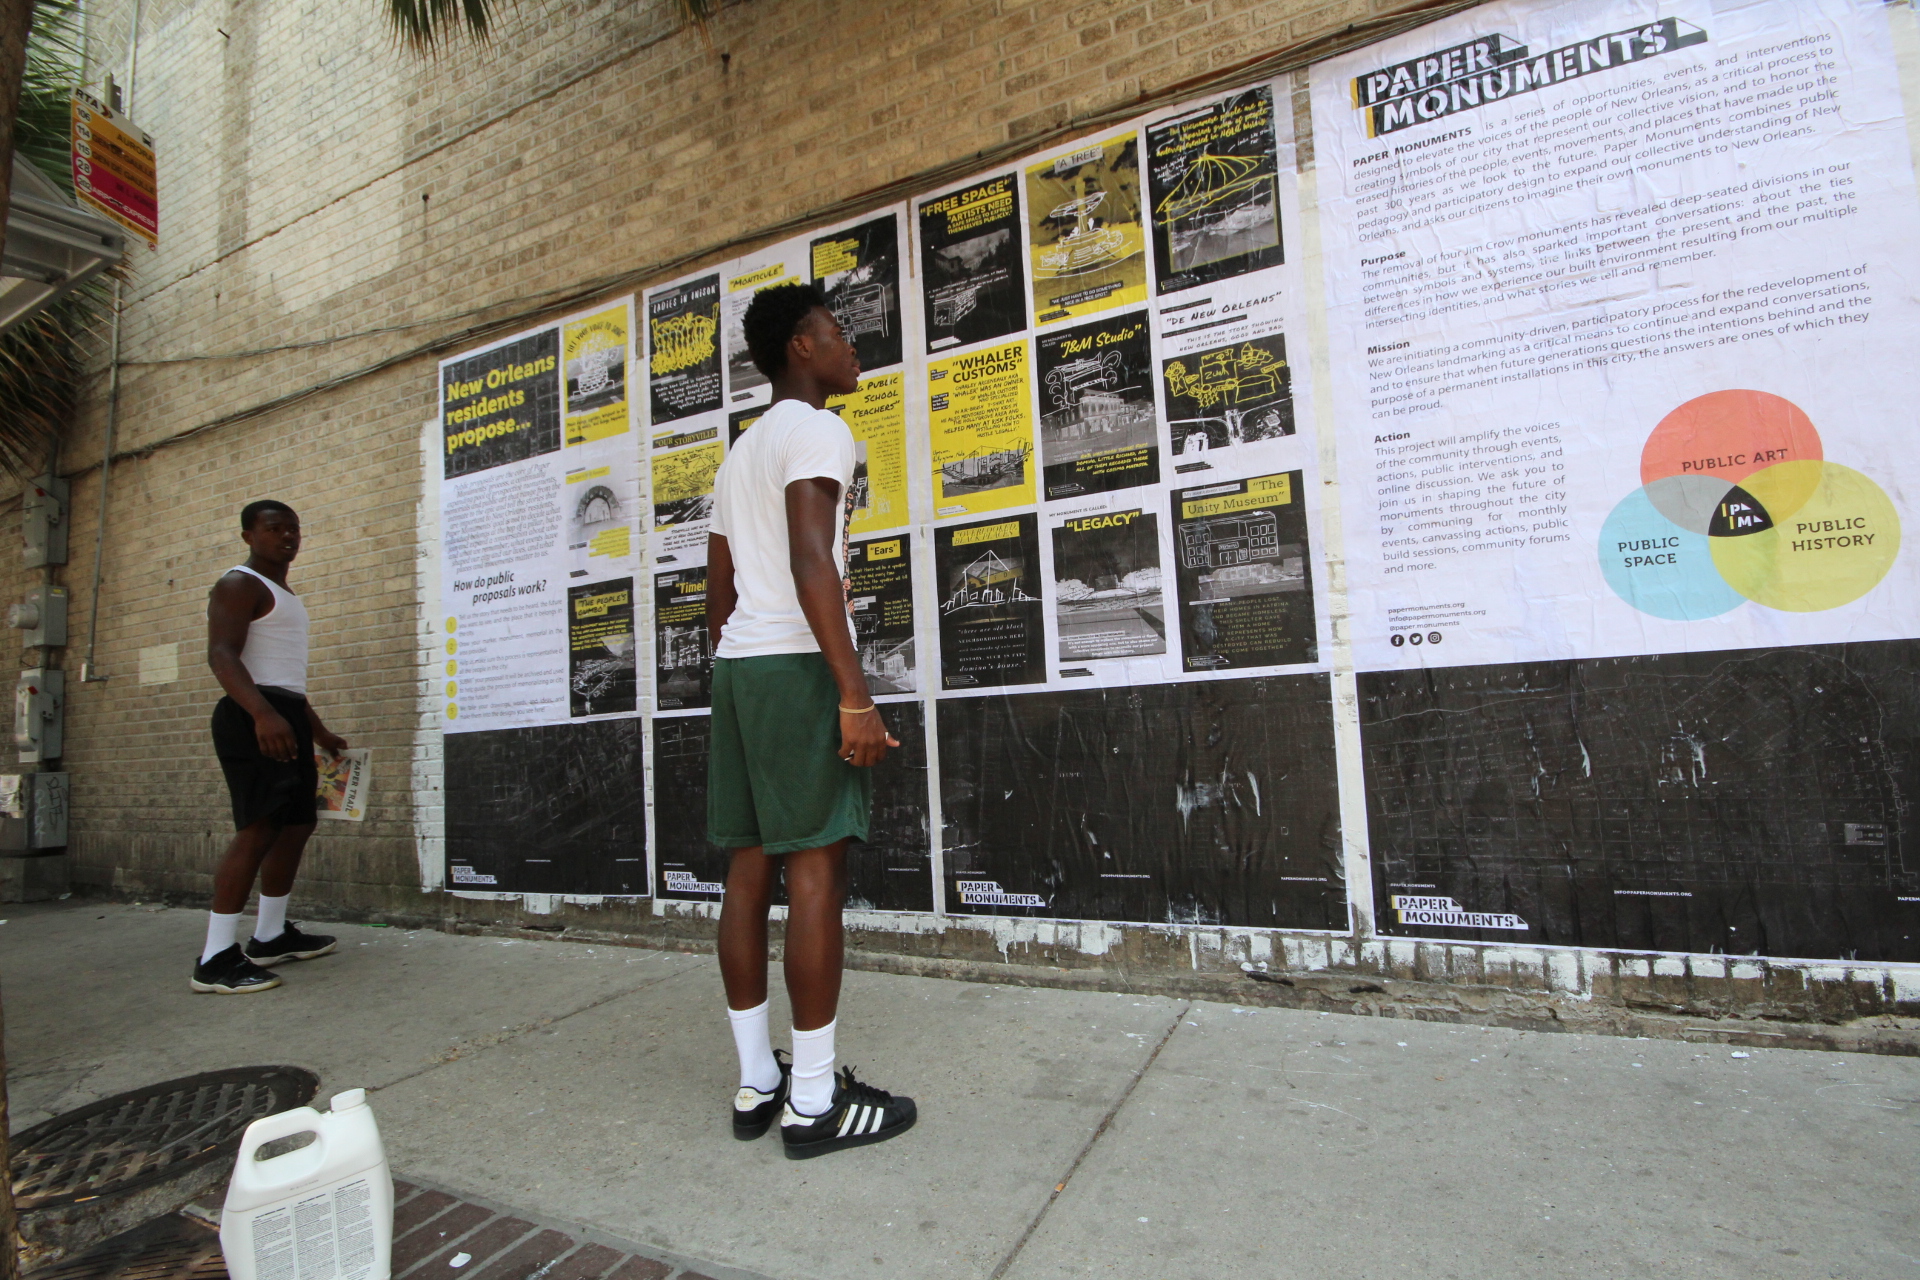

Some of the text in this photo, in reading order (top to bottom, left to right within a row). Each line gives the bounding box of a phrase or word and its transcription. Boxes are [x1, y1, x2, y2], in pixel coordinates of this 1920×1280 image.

[1367, 42, 1493, 103] PAPER
[1383, 24, 1667, 131] MONUMENTS
[76, 88, 98, 109] RTA
[77, 107, 90, 121] 106
[1057, 147, 1100, 168] "A TREE"
[1353, 127, 1472, 167] PAPER MONUMENTS
[78, 159, 90, 174] 28
[920, 178, 1011, 217] "FREE SPACE"
[948, 198, 1012, 223] "ARTISTS NEED
[948, 221, 982, 234] THEMSELVES
[1361, 251, 1406, 266] Purpose
[730, 265, 783, 288] "MONTICULE"
[1167, 291, 1281, 325] "DE NEW ORLEANS"
[1061, 324, 1141, 358] "J&M Studio"
[1367, 341, 1410, 355] Mission
[953, 346, 1022, 370] "WHALER
[447, 355, 556, 402] New Orleans
[953, 358, 1022, 383] CUSTOMS"
[867, 377, 898, 390] PUBLIC
[864, 390, 898, 403] SCHOOL
[447, 390, 525, 425] residents
[852, 400, 900, 418] TEACHERS"
[447, 418, 531, 454] propose...
[655, 437, 673, 446] "OUR
[1374, 431, 1410, 443] Action
[1375, 421, 1560, 456] This project will amplify the voices
[1376, 435, 1562, 469] of the community through events,
[1682, 448, 1788, 472] PUBLIC ART
[1377, 447, 1563, 483] actions, public interventions, and
[1253, 480, 1283, 490] "The
[1378, 462, 1564, 496] online discussion. We ask you to
[1378, 474, 1566, 510] join us in shaping the future of
[1188, 491, 1284, 515] Unity Museum"
[1380, 490, 1566, 522] monuments throughout the city
[1730, 504, 1740, 515] P
[1066, 511, 1140, 532] "LEGACY"
[1381, 504, 1567, 536] by communing for monthly
[1738, 516, 1752, 527] M
[1797, 517, 1866, 534] PUBLIC
[1382, 518, 1568, 548] events, canvassing actions, public
[1792, 534, 1875, 552] HISTORY
[870, 544, 897, 555] "Ears"
[1383, 533, 1570, 561] build sessions, community forums
[1618, 537, 1680, 552] PUBLIC
[1384, 562, 1437, 574] and more.
[1624, 553, 1677, 568] SPACE
[453, 570, 515, 592] How do public
[472, 579, 547, 606] proposals work?
[1388, 602, 1465, 614] papermonuments.org
[1389, 609, 1486, 622] info@papermonuments.org
[1390, 621, 1460, 631] @paper.monuments
[345, 760, 361, 812] PAPER TRAIL
[670, 882, 719, 891] MONUMENTS
[961, 882, 994, 892] PAPER
[965, 893, 1037, 905] MONUMENTS
[1398, 897, 1449, 910] PAPER
[1405, 911, 1514, 927] MONUMENTS
